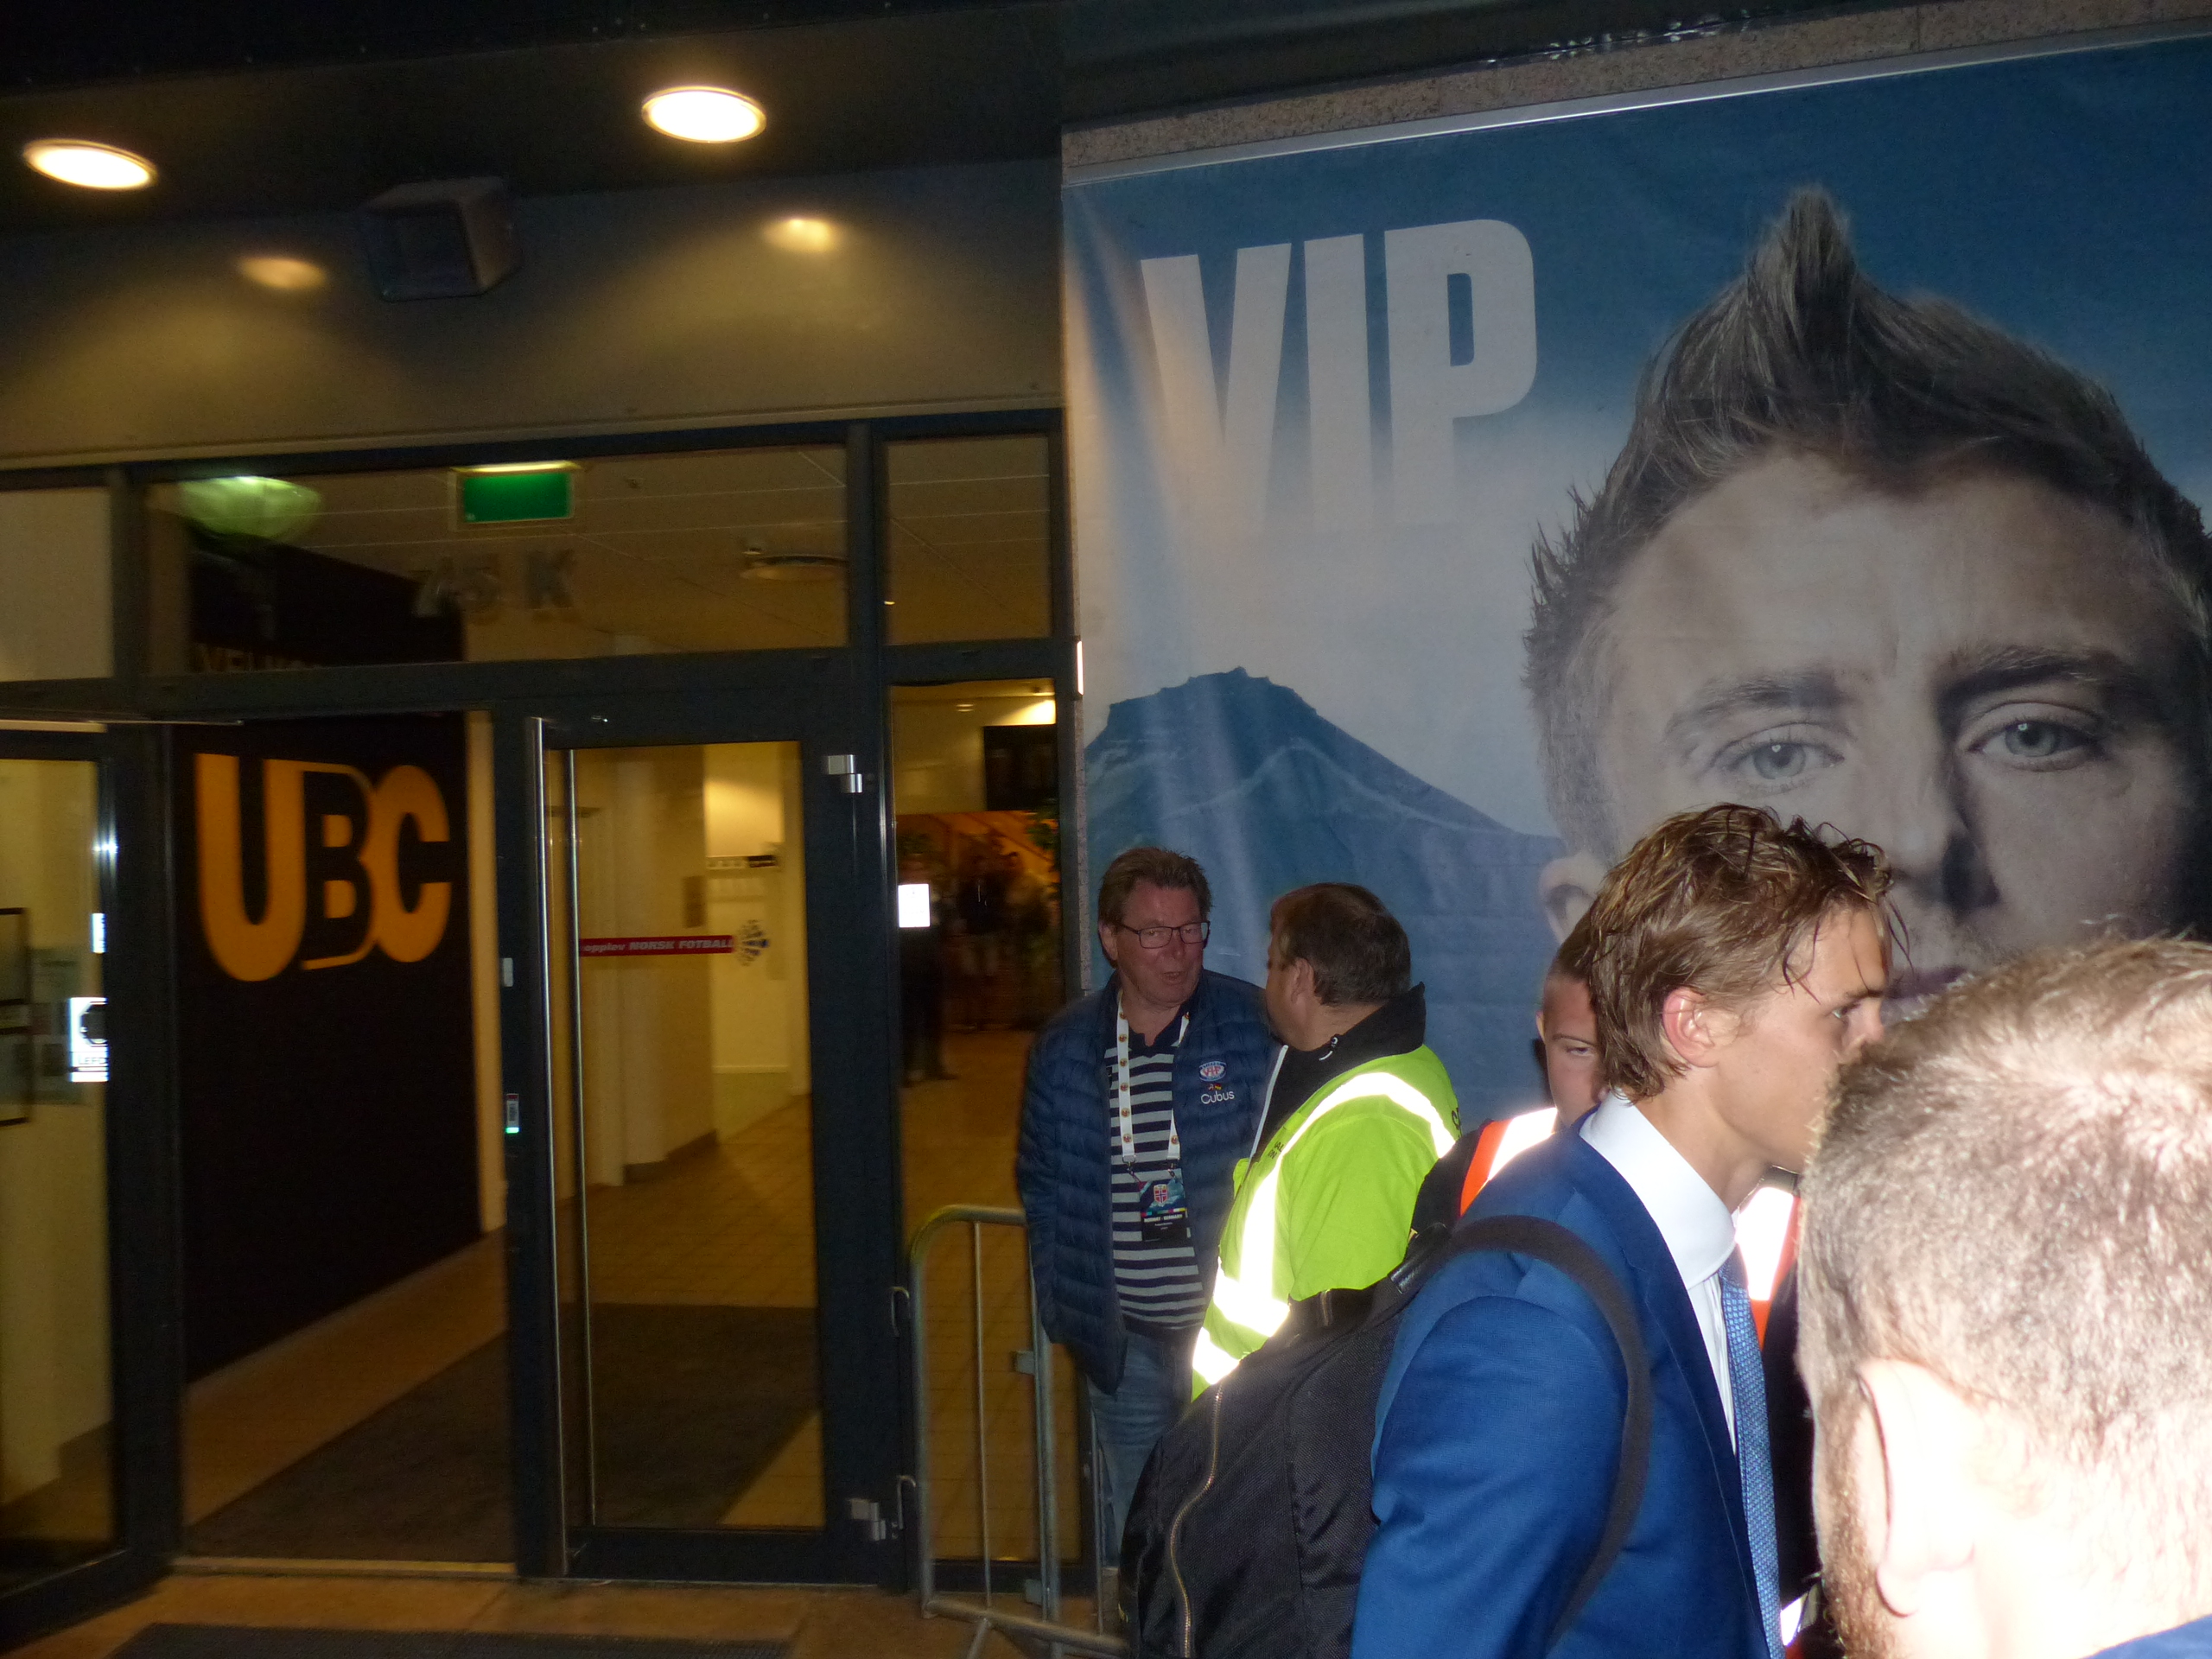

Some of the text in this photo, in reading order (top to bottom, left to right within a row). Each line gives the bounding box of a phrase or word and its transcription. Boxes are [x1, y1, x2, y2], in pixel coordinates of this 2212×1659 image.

[1140, 219, 1537, 518] VIP
[194, 753, 453, 982] UBC
[629, 940, 675, 950] NORSK
[1200, 1090, 1235, 1104] Cubus
